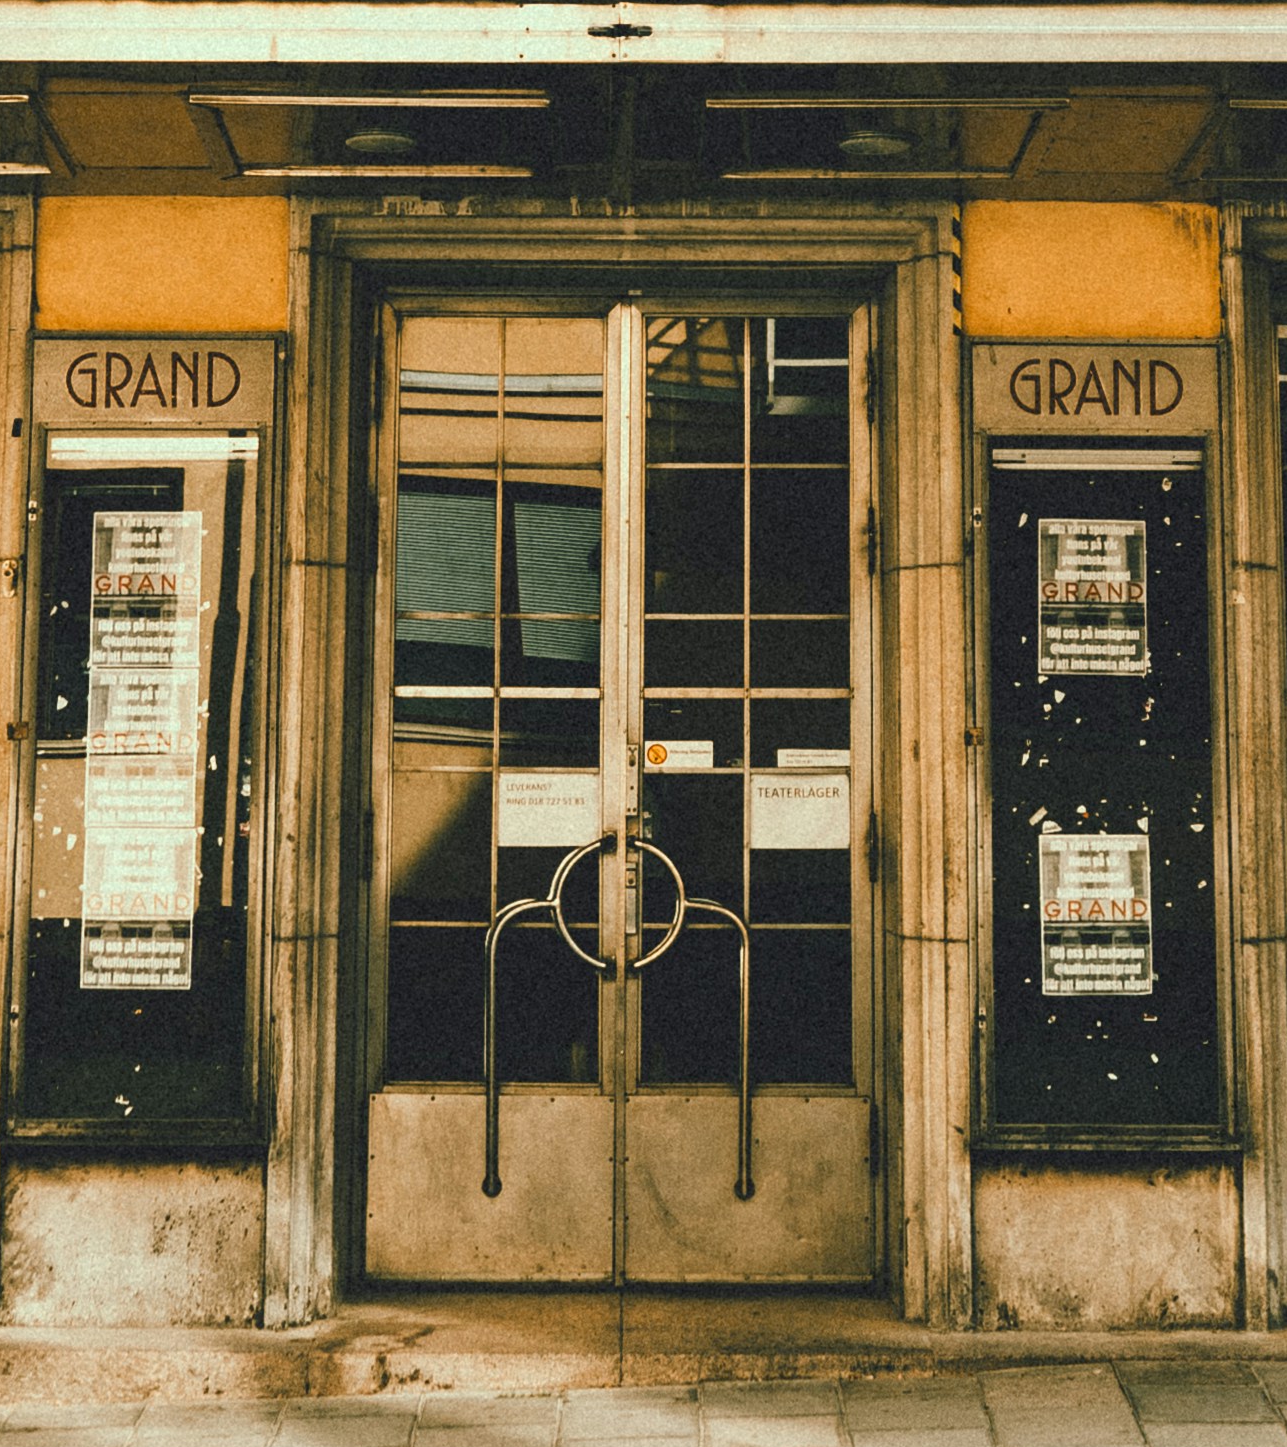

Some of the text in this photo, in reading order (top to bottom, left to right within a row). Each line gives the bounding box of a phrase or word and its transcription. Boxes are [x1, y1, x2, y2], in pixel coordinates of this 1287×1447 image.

[66, 352, 241, 408] GRAND
[1010, 358, 1183, 415] GRAND
[1049, 524, 1065, 534] alla
[1068, 522, 1087, 534] våra
[146, 530, 157, 543] på
[1090, 537, 1102, 551] på
[1104, 539, 1118, 549] vår
[95, 575, 197, 592] GRAND
[1042, 582, 1143, 600] GRAND
[116, 621, 132, 631] oss
[135, 618, 146, 632] på
[1047, 626, 1139, 640] följ oss på instagram
[1050, 643, 1136, 655] @kulturhusetgrand
[1042, 658, 1054, 669] för
[1057, 659, 1069, 669] att
[1071, 659, 1088, 669] inte
[1090, 659, 1116, 670] missa
[92, 733, 193, 749] GRAND
[506, 783, 552, 791] LEVERANS?
[506, 797, 526, 805] RING
[546, 797, 560, 805] 727
[562, 797, 572, 805] 51
[87, 894, 190, 911] GRAND
[1044, 900, 1148, 917] GRAND
[107, 942, 122, 952] oss
[125, 939, 137, 953] på
[139, 941, 185, 953] instagram
[1050, 944, 1144, 960] följ oss på instagram
[1061, 979, 1073, 990] att
[1075, 978, 1093, 990] inte
[1095, 978, 1121, 990] missa
